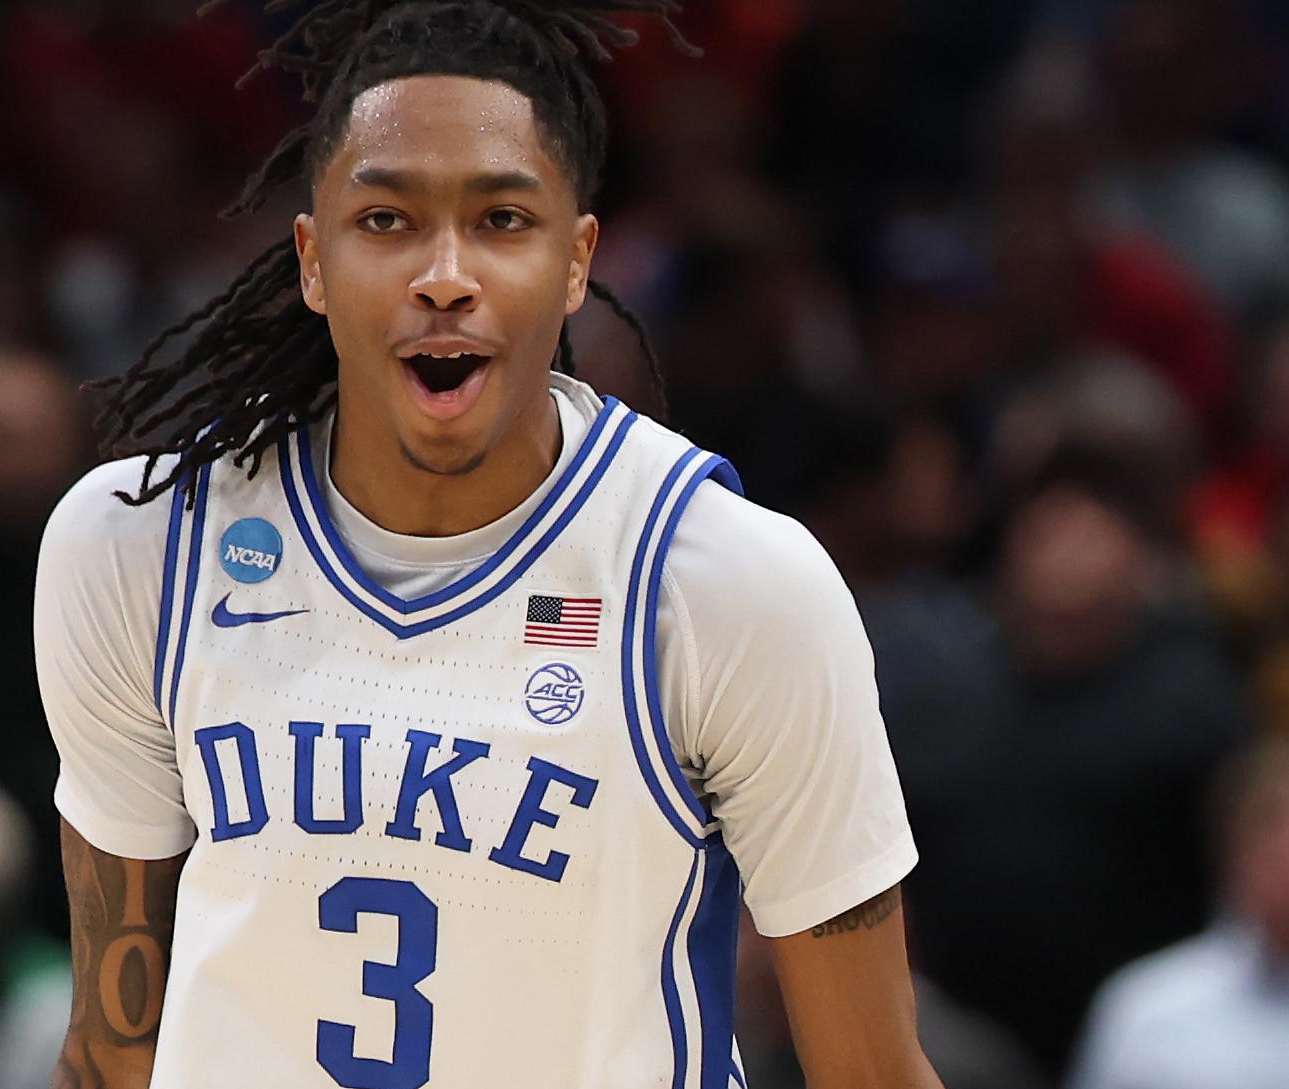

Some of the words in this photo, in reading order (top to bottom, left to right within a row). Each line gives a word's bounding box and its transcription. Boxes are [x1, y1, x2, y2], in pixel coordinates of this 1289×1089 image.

[224, 544, 276, 571] NCAA
[533, 682, 583, 699] ACC
[194, 721, 599, 882] DUKE
